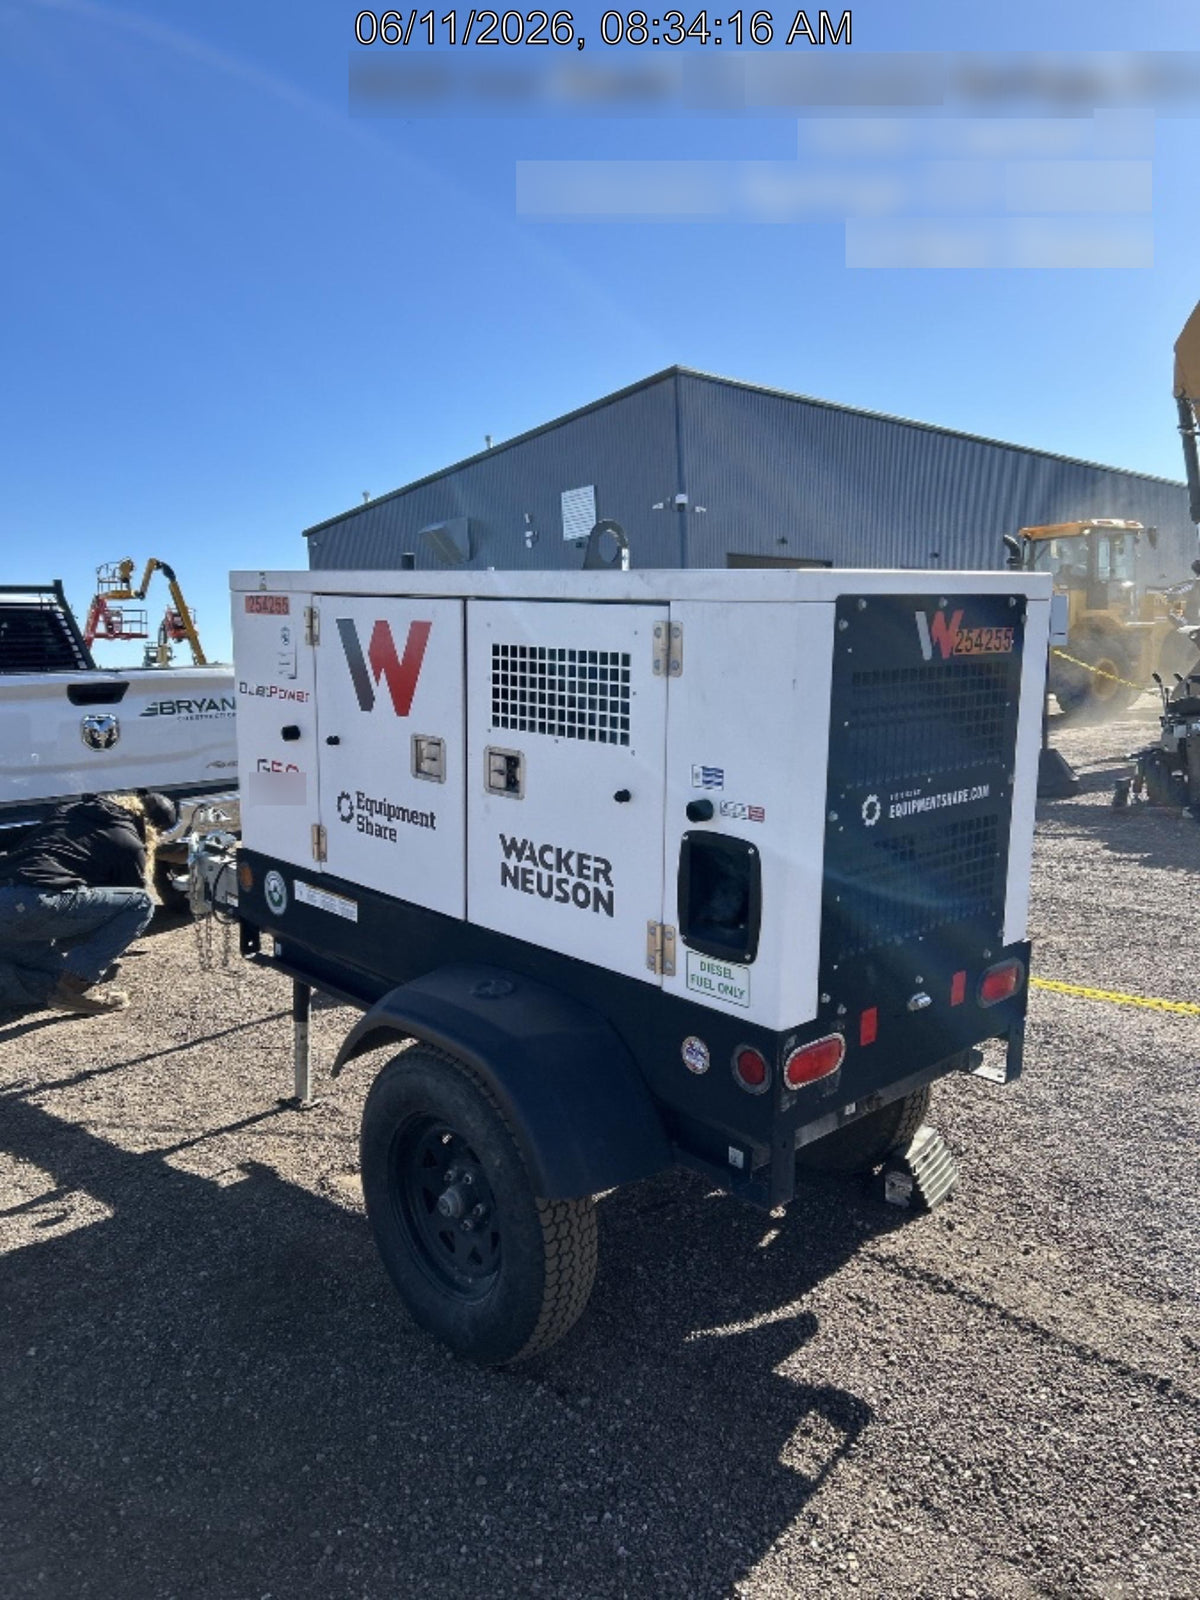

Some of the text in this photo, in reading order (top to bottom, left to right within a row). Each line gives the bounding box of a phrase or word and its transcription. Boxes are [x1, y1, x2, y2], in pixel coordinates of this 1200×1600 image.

[955, 629, 1012, 653] 254255
[159, 697, 236, 716] BRYAN
[356, 791, 436, 830] Equipment
[357, 813, 398, 843] Share
[499, 833, 614, 888] WACKER
[500, 861, 614, 918] NEUSON
[700, 960, 735, 980] DIESEL
[690, 973, 746, 1000] FUEL ONLY
